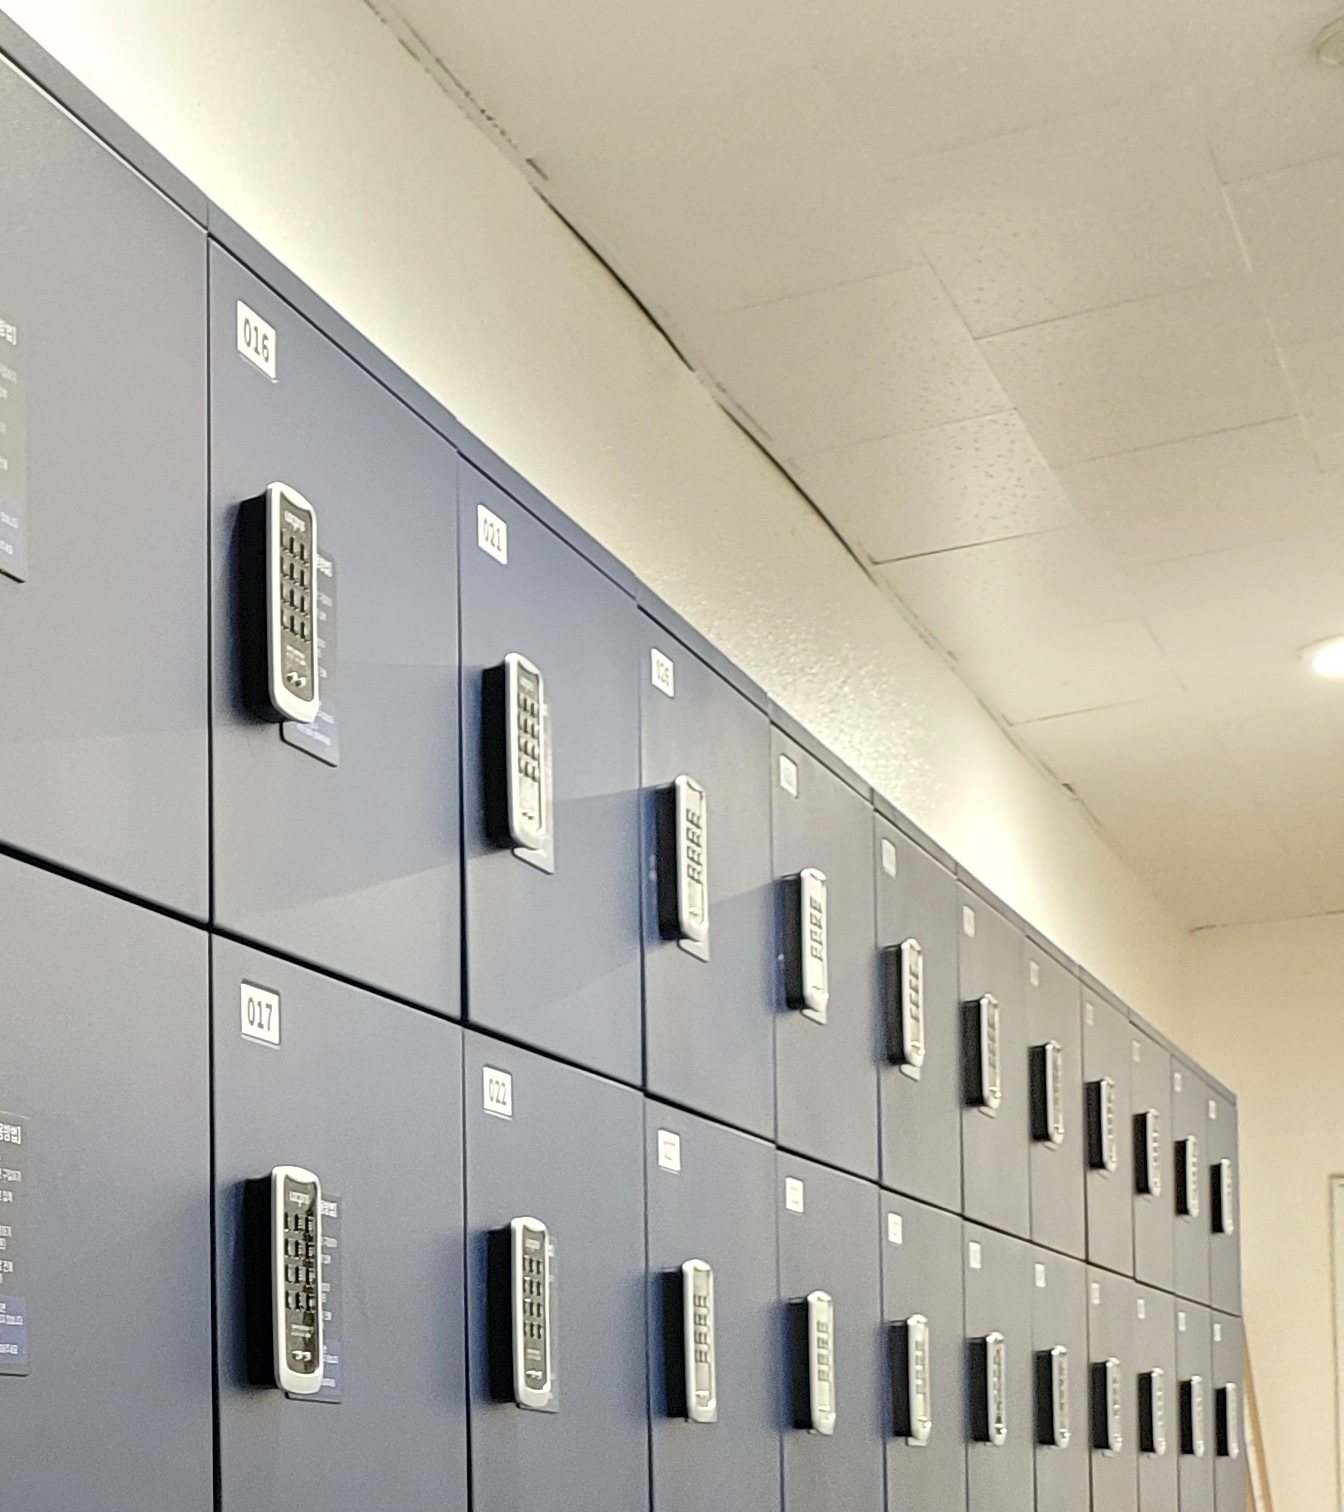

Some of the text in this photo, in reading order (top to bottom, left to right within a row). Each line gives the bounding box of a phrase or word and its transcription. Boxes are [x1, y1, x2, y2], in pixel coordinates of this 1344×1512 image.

[243, 318, 270, 362] 016
[483, 517, 502, 552] 021
[247, 997, 273, 1031] 017
[488, 1078, 507, 1106] 022
